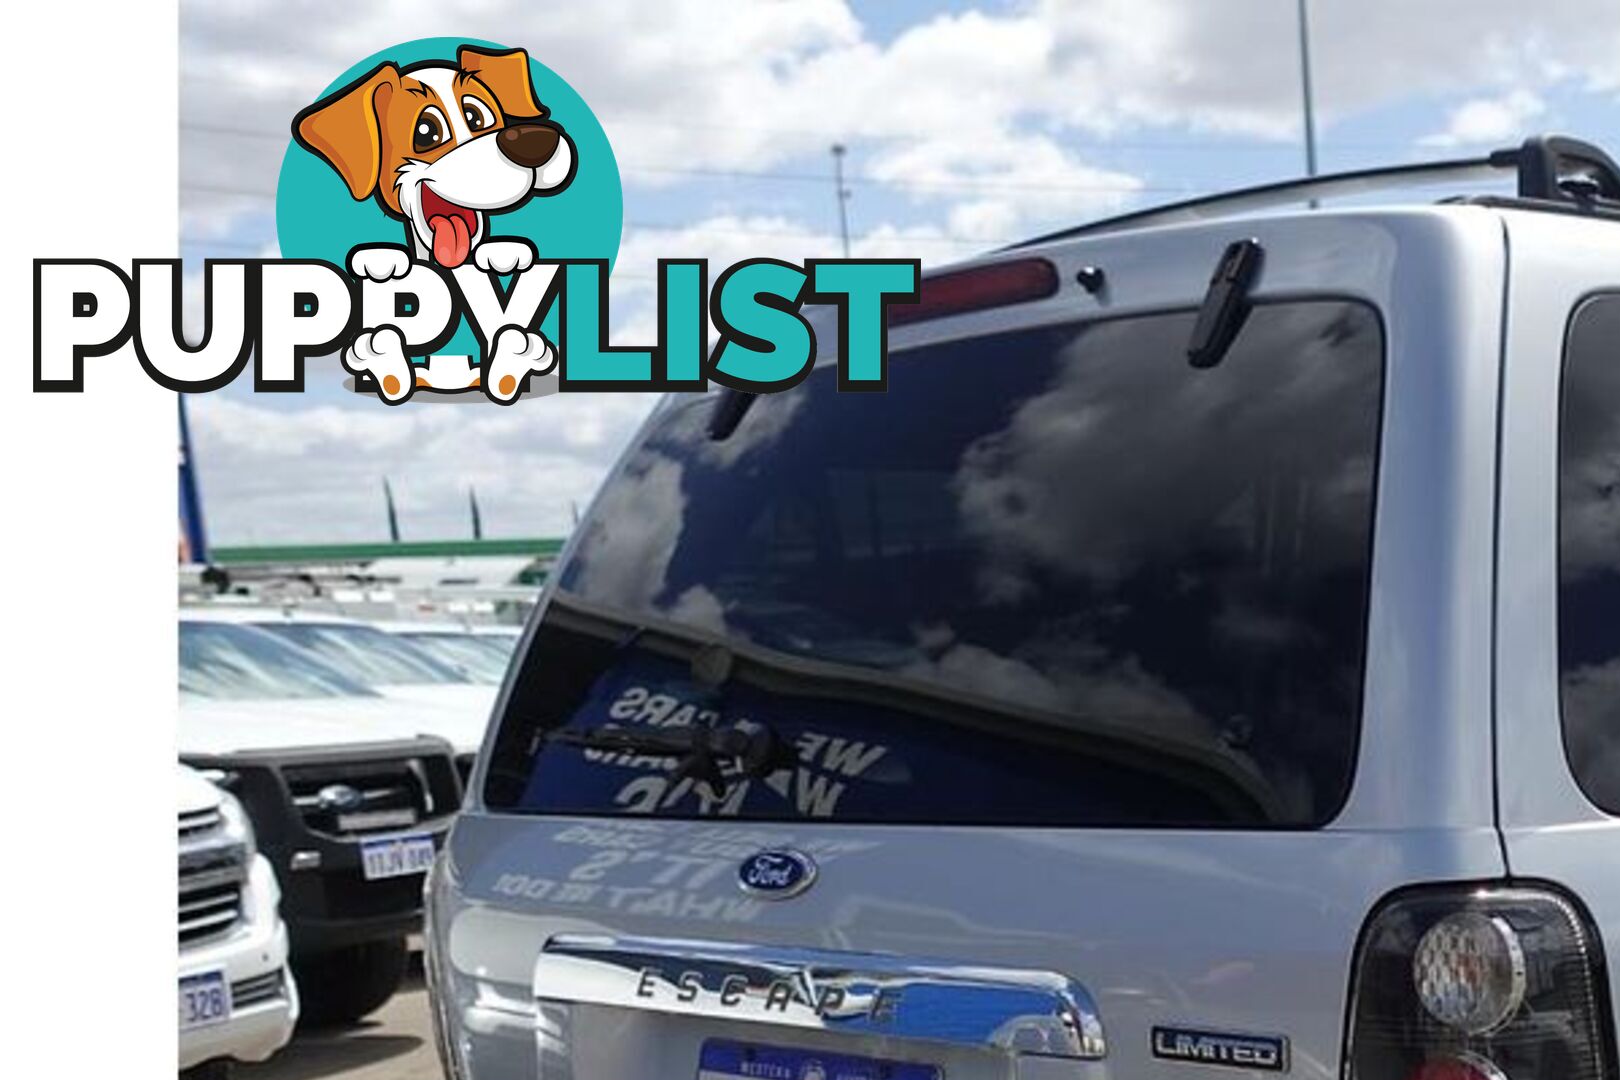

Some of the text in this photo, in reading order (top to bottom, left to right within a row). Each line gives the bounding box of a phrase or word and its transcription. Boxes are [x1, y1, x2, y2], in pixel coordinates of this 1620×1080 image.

[747, 854, 794, 886] Ford
[636, 965, 898, 1022] ESCAPE
[1155, 1030, 1280, 1066] LIMITED
